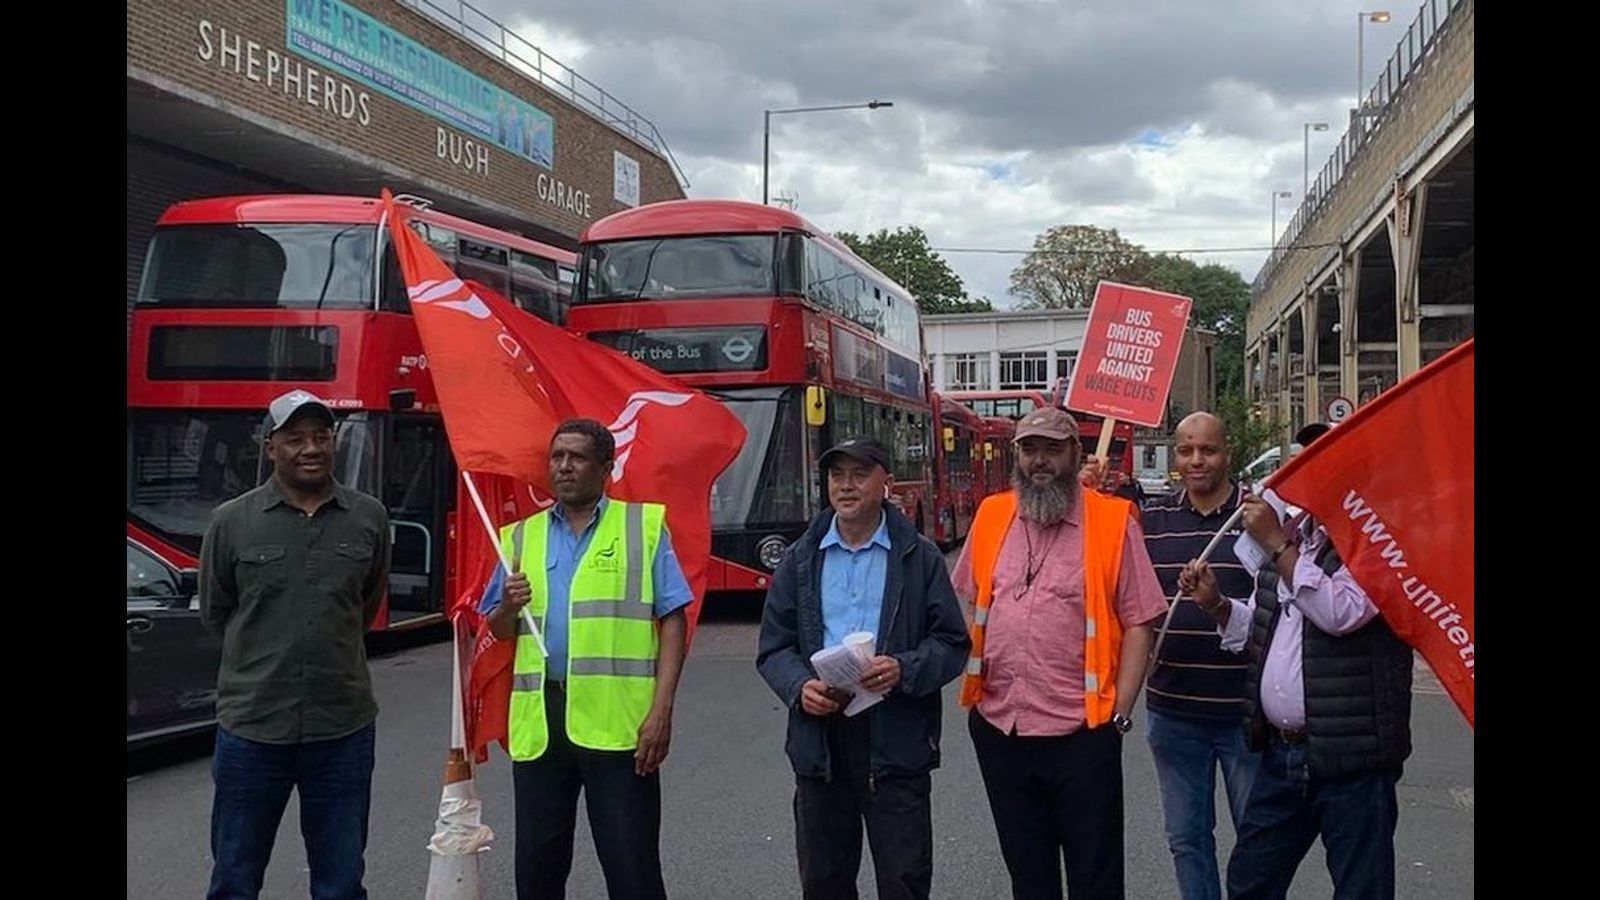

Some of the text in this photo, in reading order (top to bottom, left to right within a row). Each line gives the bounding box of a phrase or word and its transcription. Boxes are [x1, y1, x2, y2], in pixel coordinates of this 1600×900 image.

[379, 30, 491, 110] RECRUITING
[198, 20, 370, 127] SHEPHERDS
[437, 127, 489, 176] BUSH
[537, 173, 591, 218] GARAGE
[1125, 308, 1153, 327] BUS
[1106, 323, 1163, 347] DRIVERS
[632, 348, 647, 360] of
[650, 347, 673, 360] the
[677, 347, 701, 358] Bus
[1106, 341, 1154, 364] UNITED
[1096, 358, 1155, 382] AGAINST
[1084, 374, 1158, 402] WAGE CUTS
[1336, 405, 1345, 417] 5
[1342, 489, 1474, 681] www.unitet
